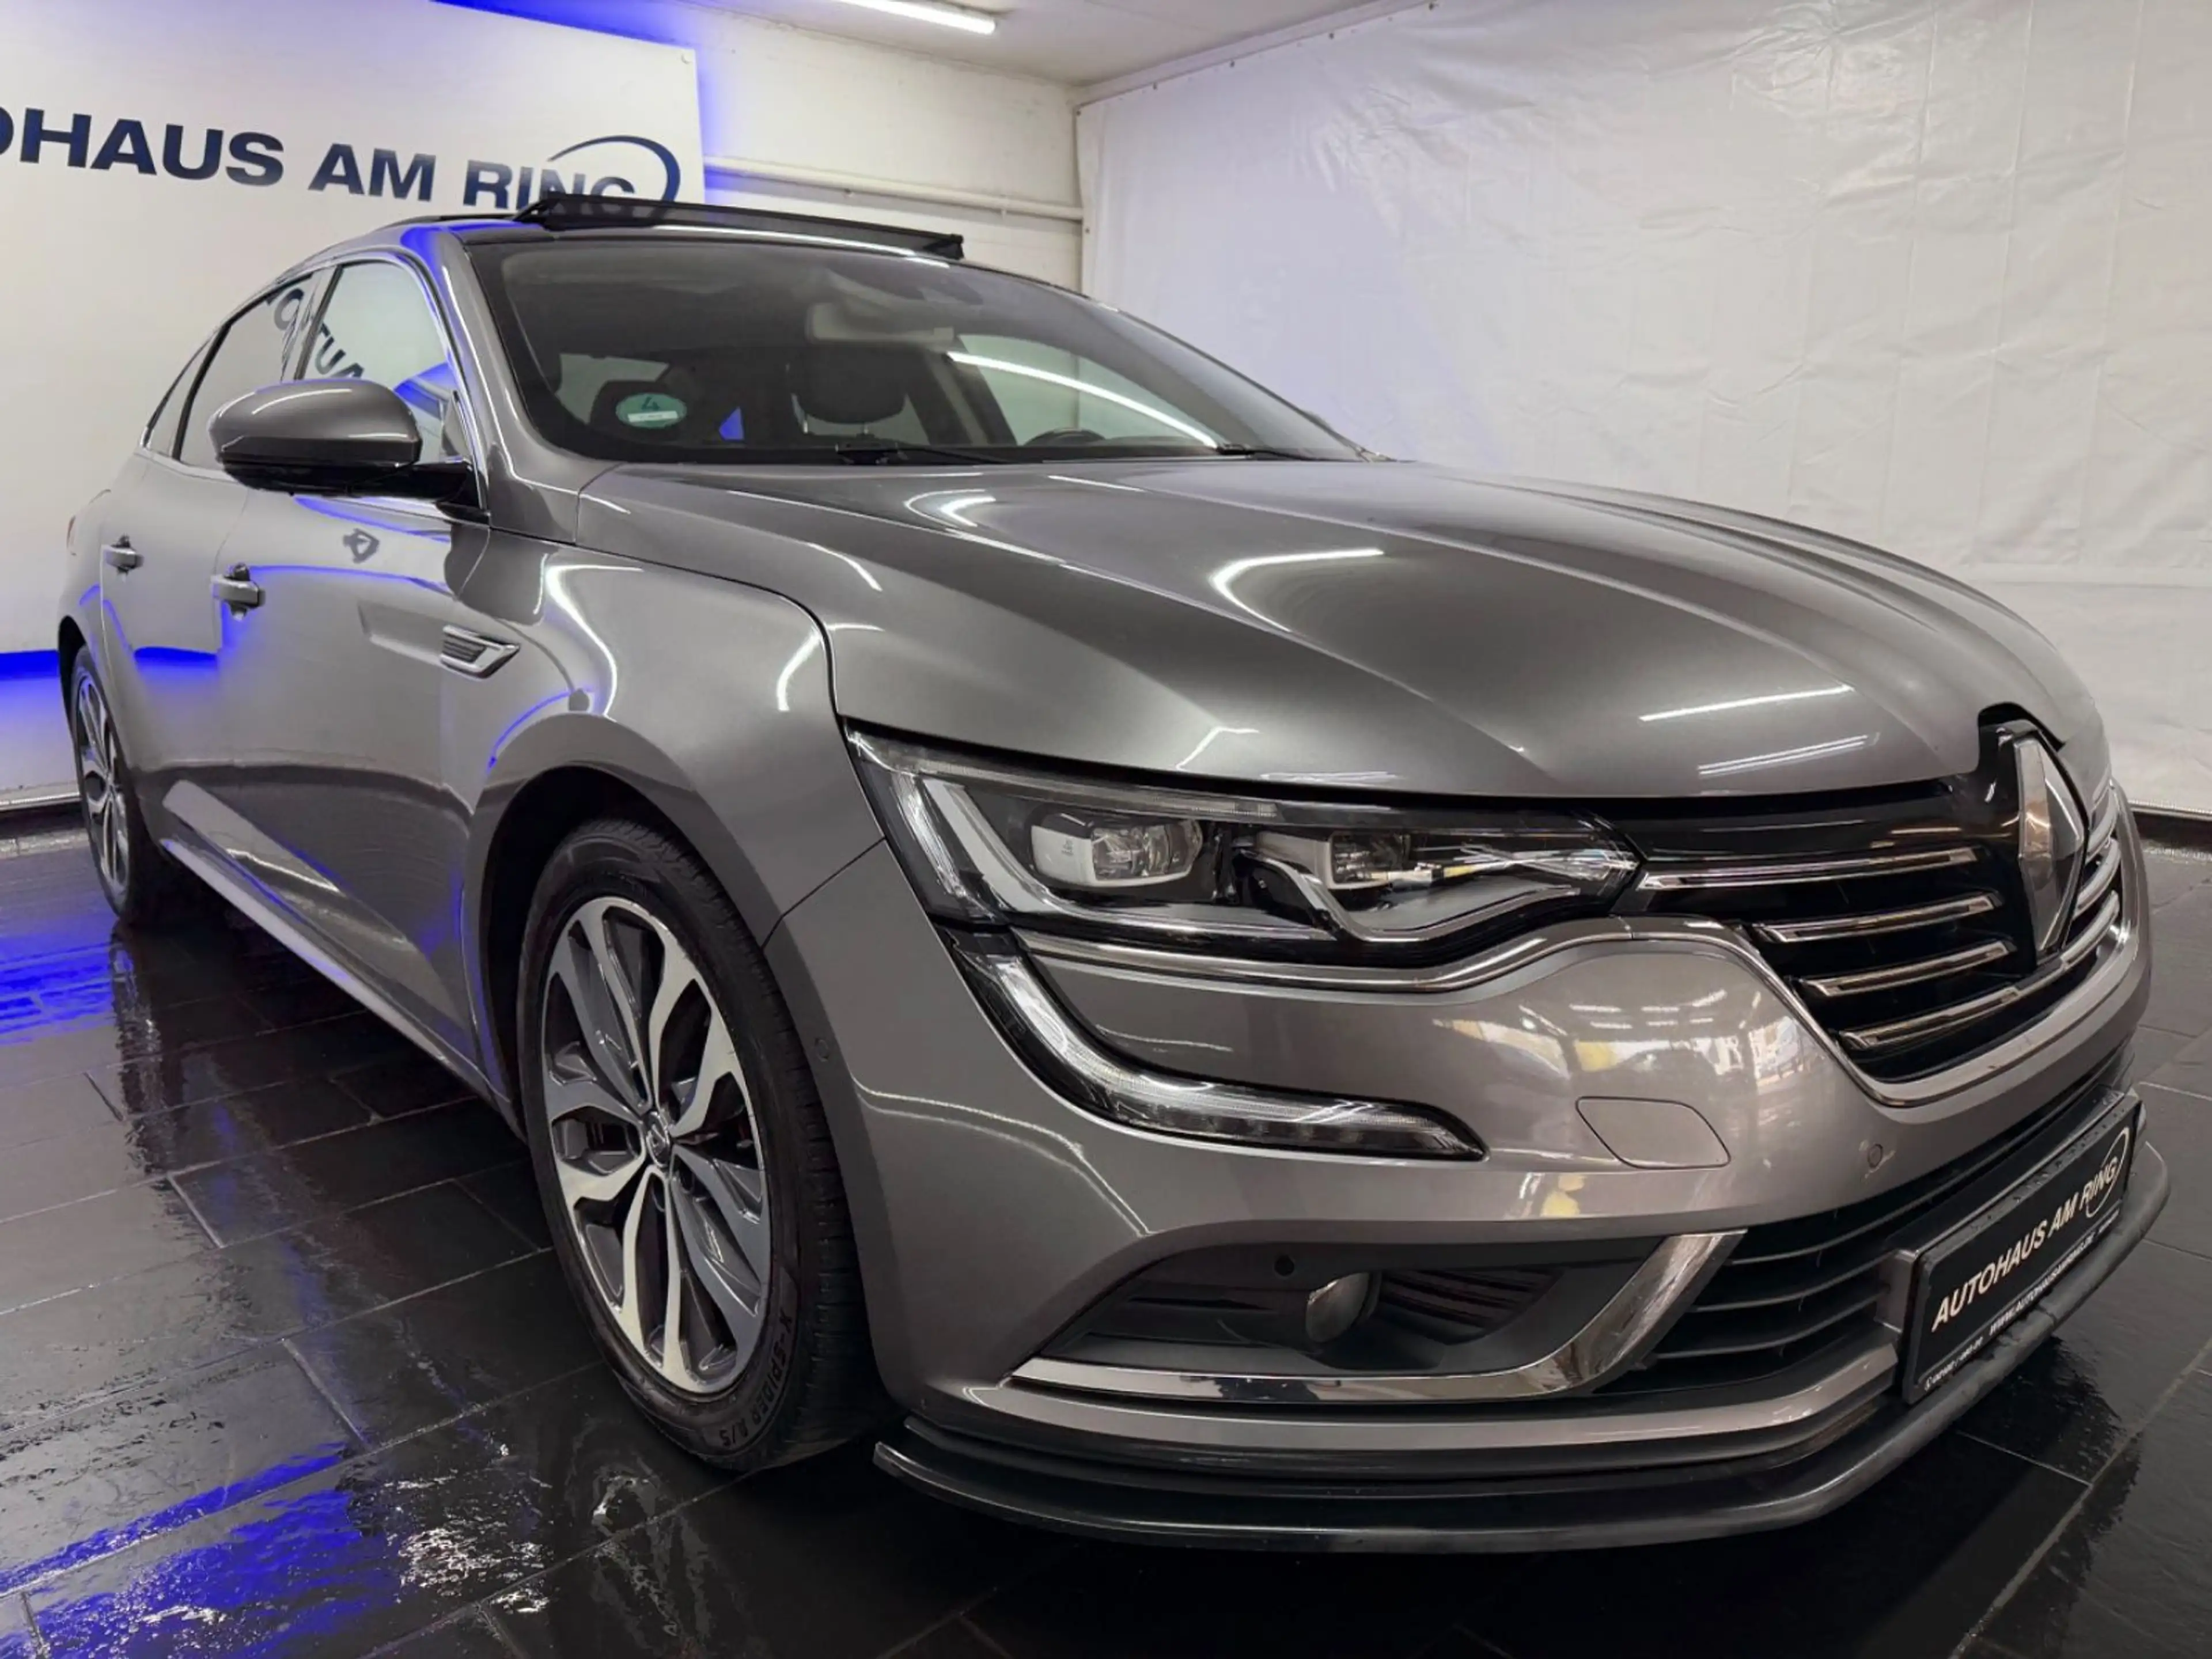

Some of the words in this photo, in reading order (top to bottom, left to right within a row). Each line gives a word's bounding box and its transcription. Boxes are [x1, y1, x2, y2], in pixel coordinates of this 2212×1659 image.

[0, 106, 284, 187] HAUS
[307, 143, 436, 202] AM
[1931, 1219, 2048, 1333] AUTOHAUS
[2047, 1191, 2080, 1238] AM
[2079, 1156, 2118, 1211] RING
